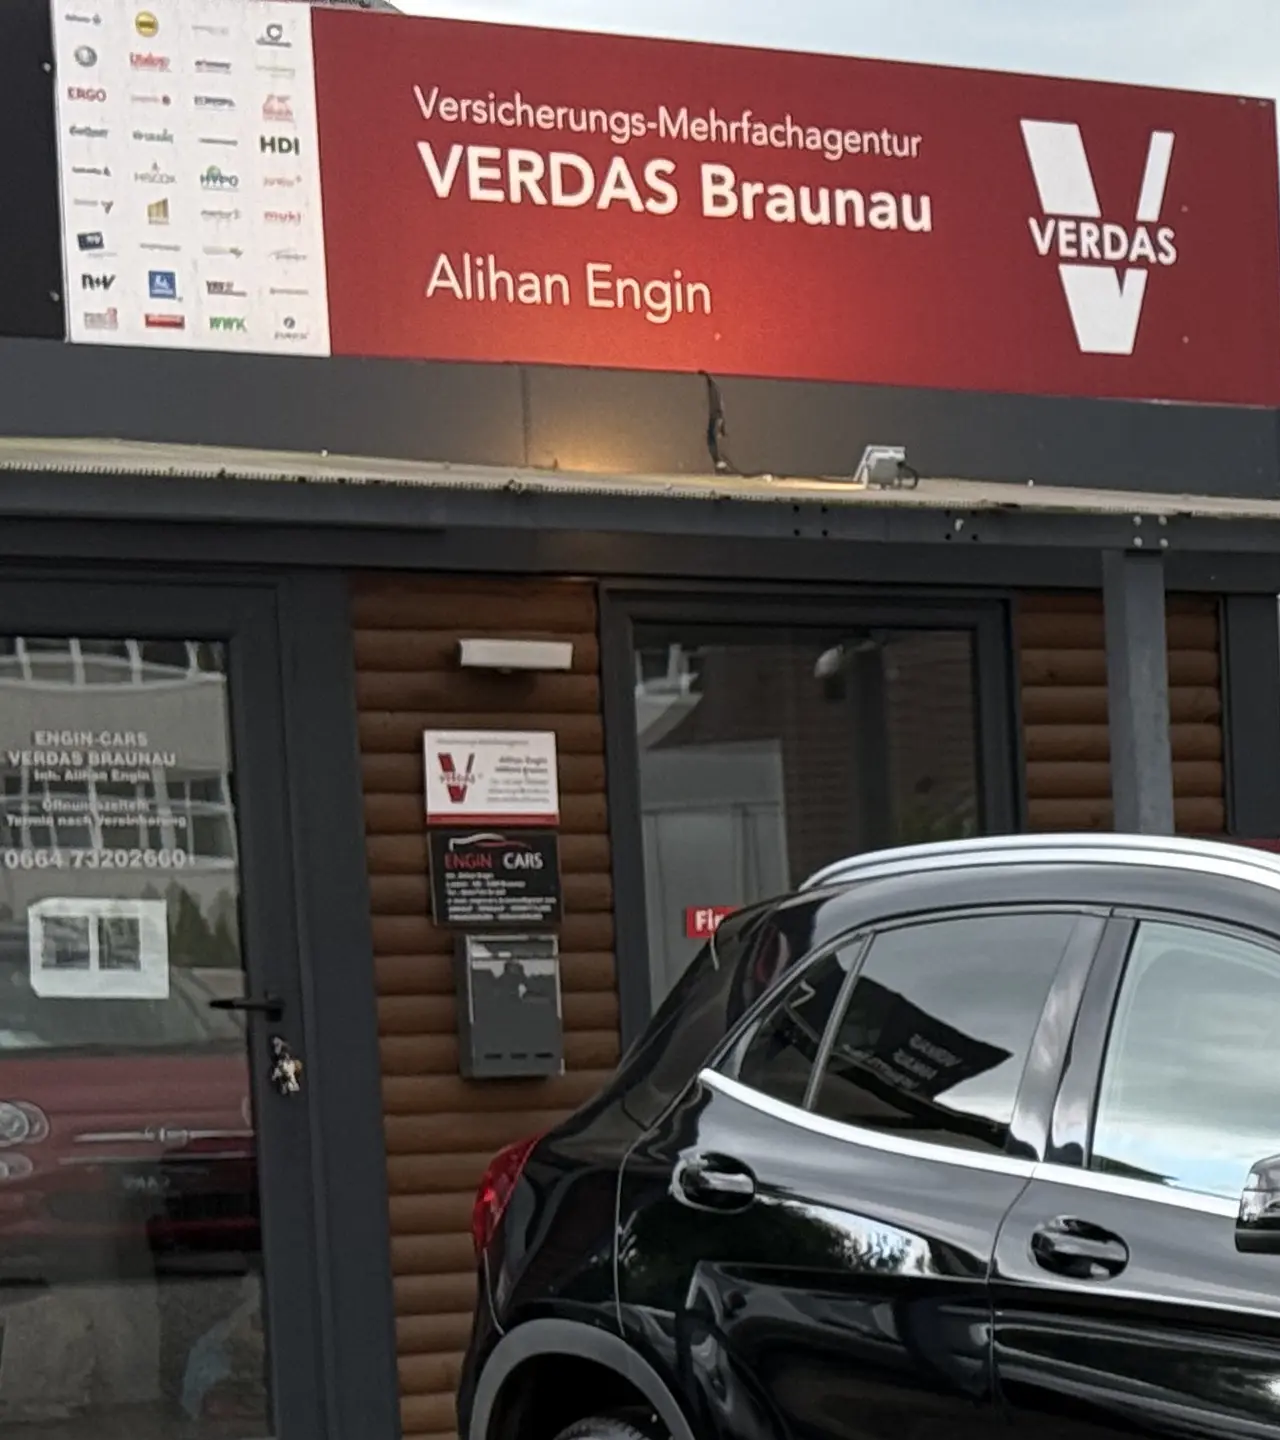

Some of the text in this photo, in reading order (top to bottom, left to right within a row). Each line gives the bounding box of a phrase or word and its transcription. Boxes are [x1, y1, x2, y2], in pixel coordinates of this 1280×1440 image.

[67, 86, 107, 103] ERGO
[413, 84, 923, 161] Versicherungs-Mehrfachagentur
[259, 135, 300, 156] HDI
[416, 140, 934, 233] VERDAS Braunau
[1028, 216, 1179, 266] VERDAS
[425, 252, 713, 325] Alihan Engin
[208, 315, 248, 332] WWK
[34, 731, 149, 747] ENGIN-CARS
[7, 751, 177, 768] VERDAS BRAUNAU
[111, 770, 151, 784] Engin
[4, 849, 64, 869] 0664
[444, 851, 544, 871] ENGIN CARS
